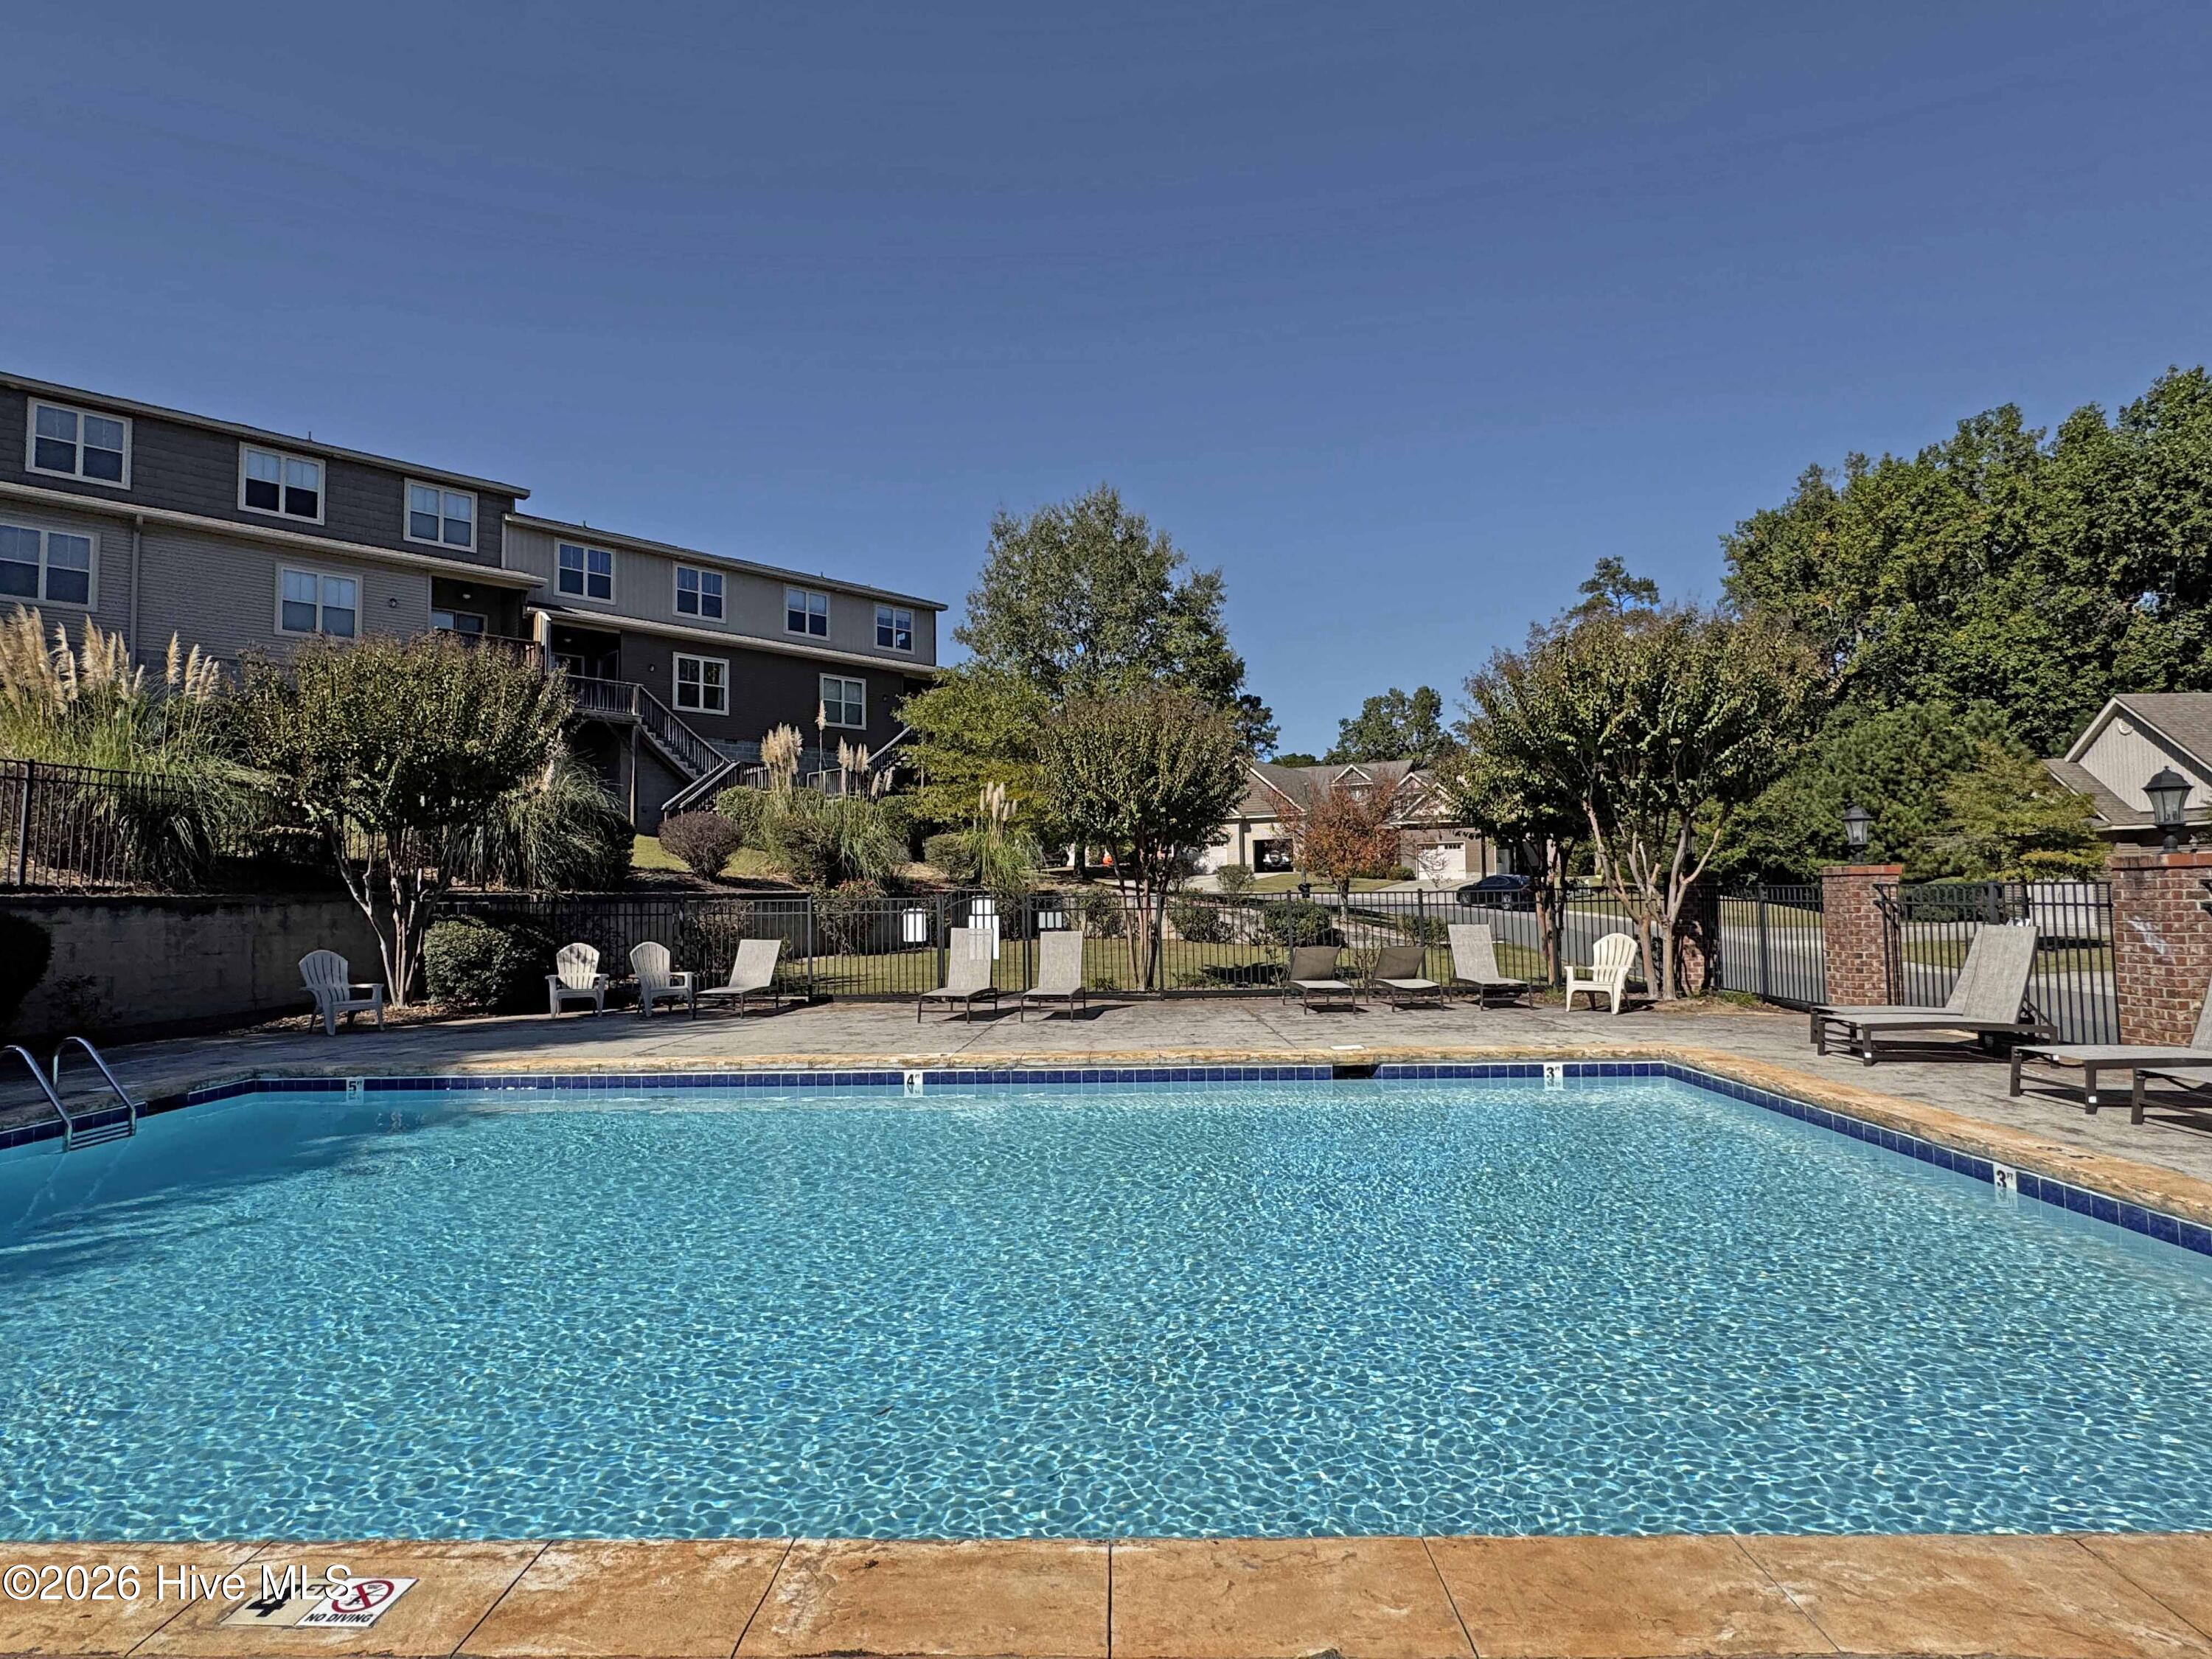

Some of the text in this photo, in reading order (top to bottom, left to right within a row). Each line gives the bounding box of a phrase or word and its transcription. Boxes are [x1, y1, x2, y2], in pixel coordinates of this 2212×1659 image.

[1546, 1066, 1554, 1079] 3
[907, 1074, 914, 1085] 4
[349, 1080, 357, 1091] 5
[1997, 1169, 2007, 1188] 3
[304, 1613, 374, 1622] NO DIVING
